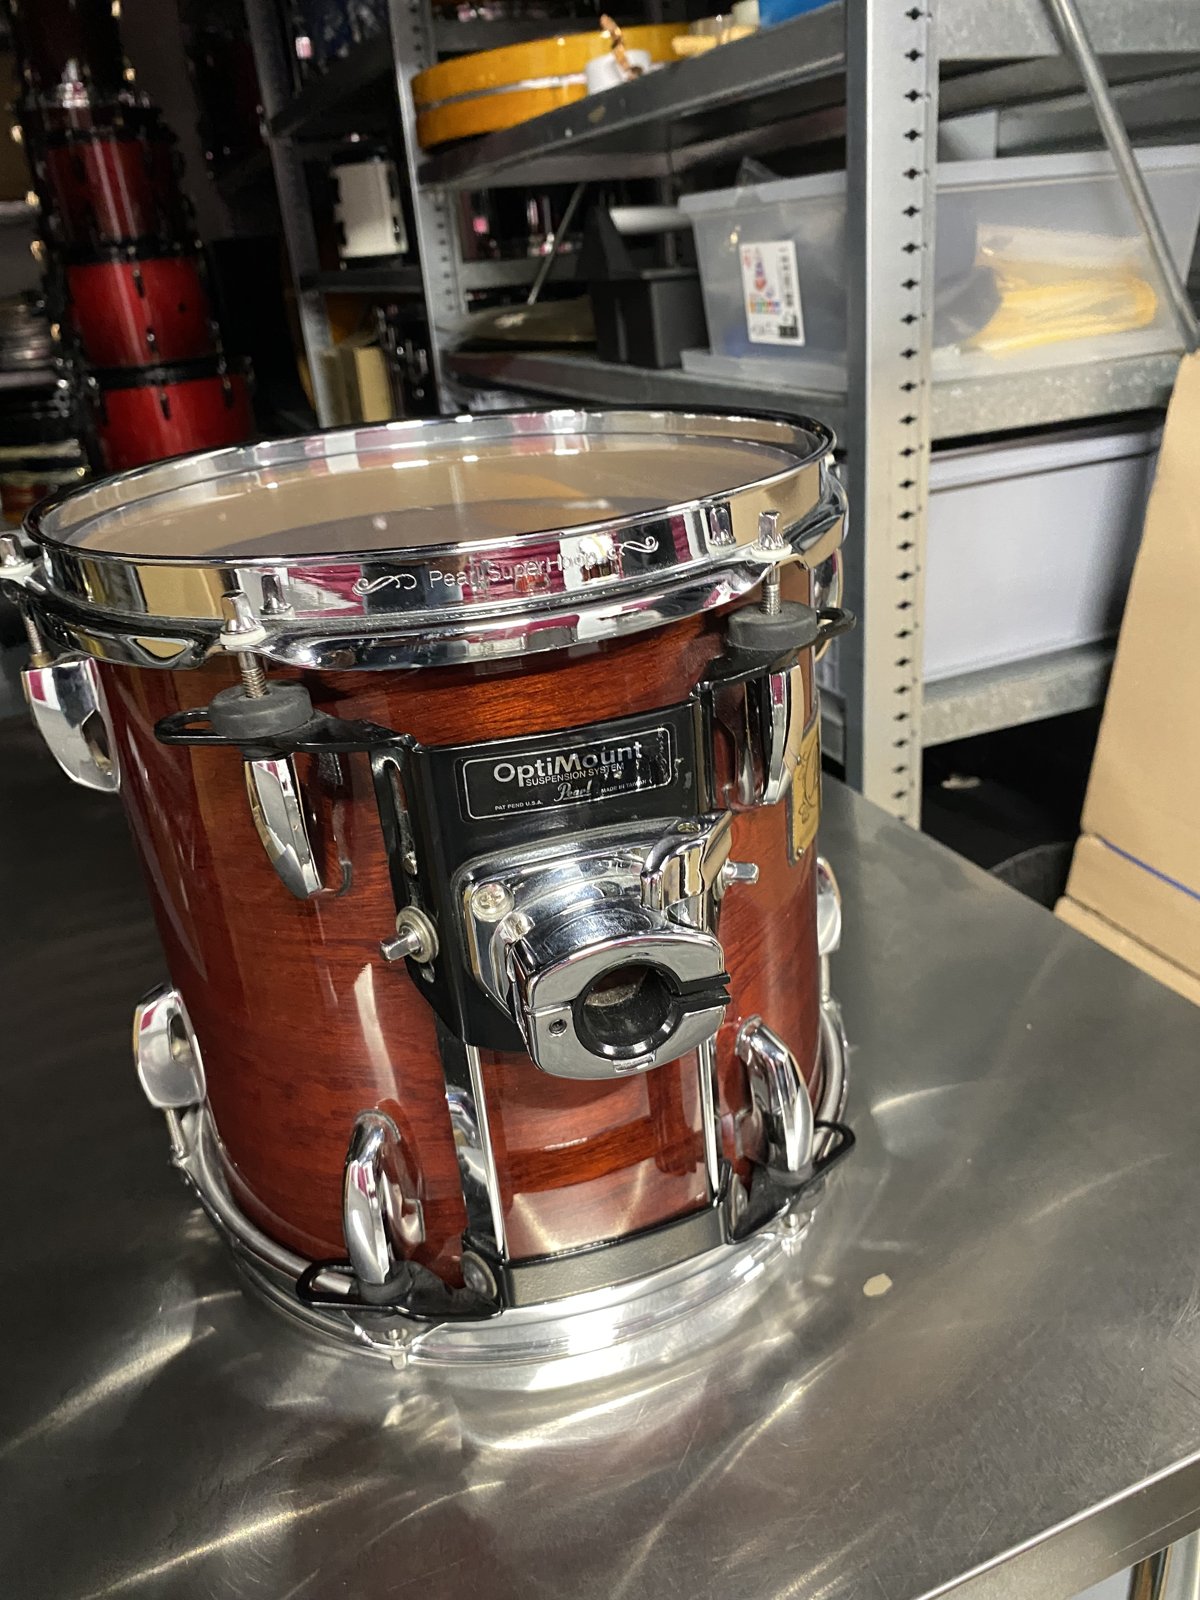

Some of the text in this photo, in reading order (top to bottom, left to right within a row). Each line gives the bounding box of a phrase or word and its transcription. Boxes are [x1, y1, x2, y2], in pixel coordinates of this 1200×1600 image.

[493, 741, 642, 787] OptiMount
[525, 762, 624, 786] SUSPENSION SYSTEM
[554, 779, 592, 802] Pearl
[600, 785, 618, 793] MADE
[508, 801, 524, 809] PEND
